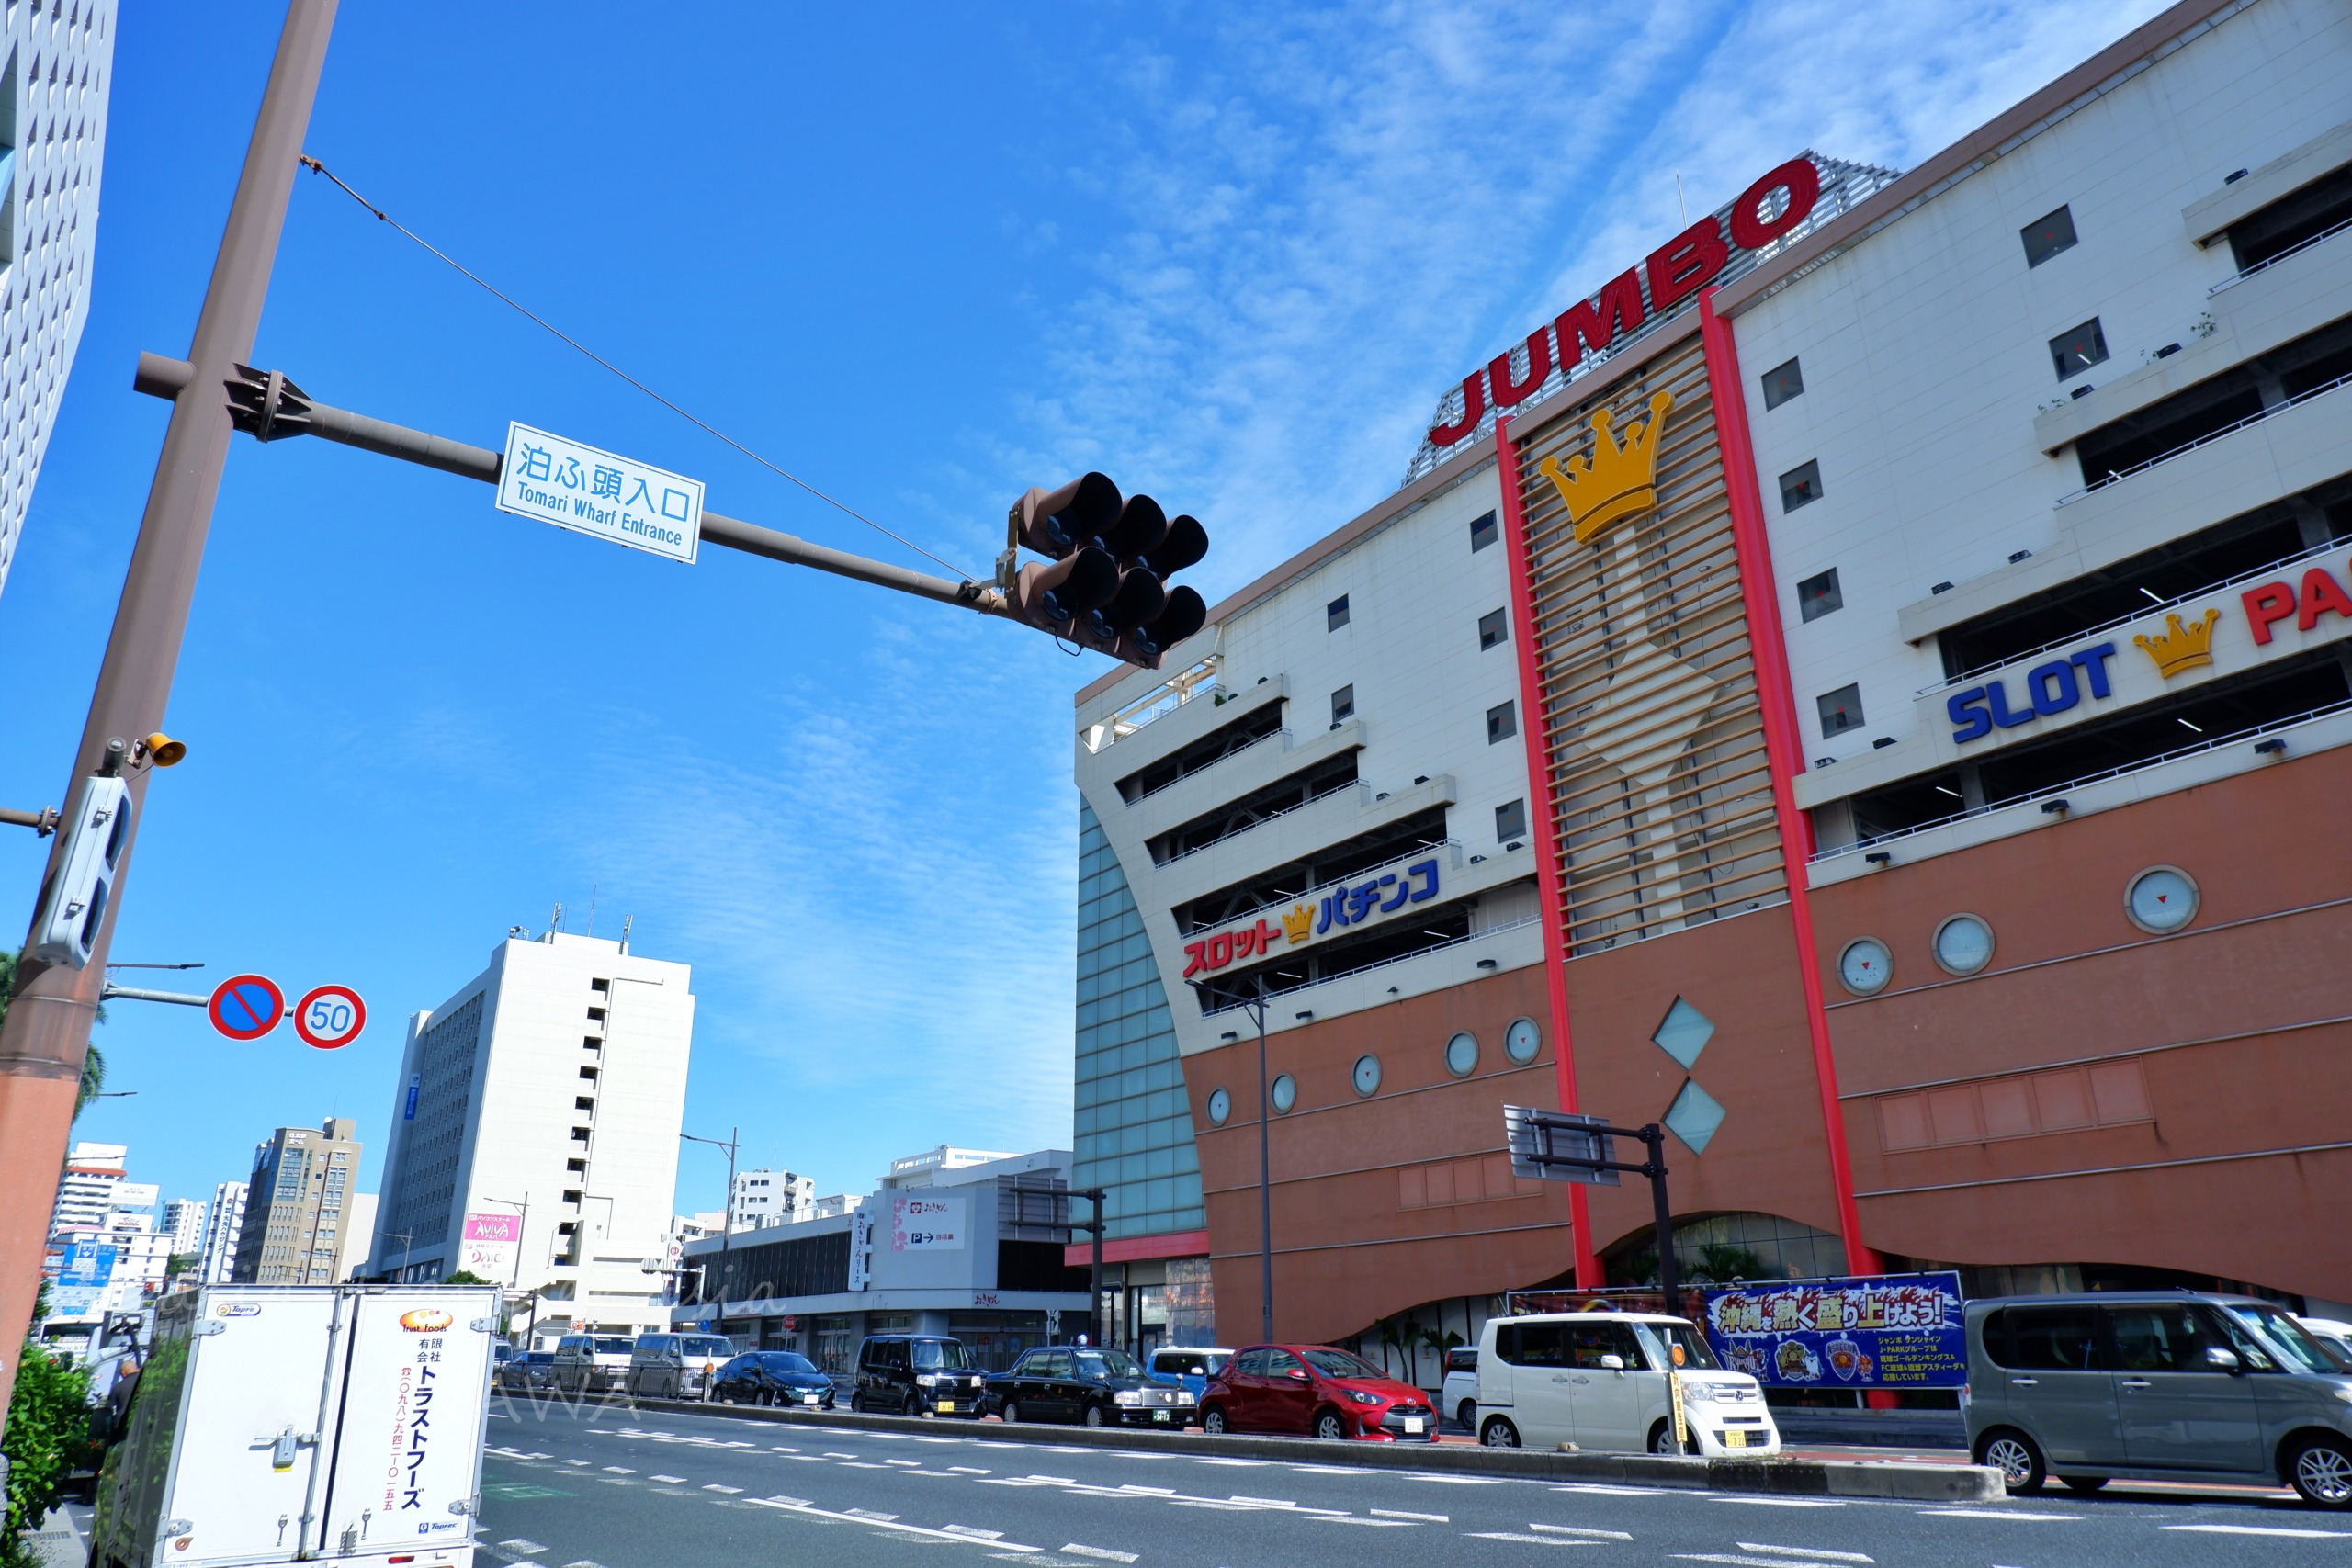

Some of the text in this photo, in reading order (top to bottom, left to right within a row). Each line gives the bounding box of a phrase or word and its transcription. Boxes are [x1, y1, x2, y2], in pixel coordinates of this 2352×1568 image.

[1429, 157, 1821, 447] JUMBO
[516, 442, 690, 523] 泊ふ頭入口
[517, 480, 683, 546] Tomari Wharf Entrance
[1946, 555, 2352, 745] SLOT PA
[1182, 858, 1440, 978] スロット パチンコ
[310, 1000, 351, 1032] 50
[402, 1323, 447, 1333] Trust Foods
[1719, 1293, 1944, 1332] 沖縄を熱く盛り上げよう!
[417, 1351, 441, 1363] 会社
[419, 1338, 443, 1349] 有限
[1878, 1336, 1941, 1345] ジャンボ サンシャイン
[401, 1365, 436, 1510] トラストフーズ
